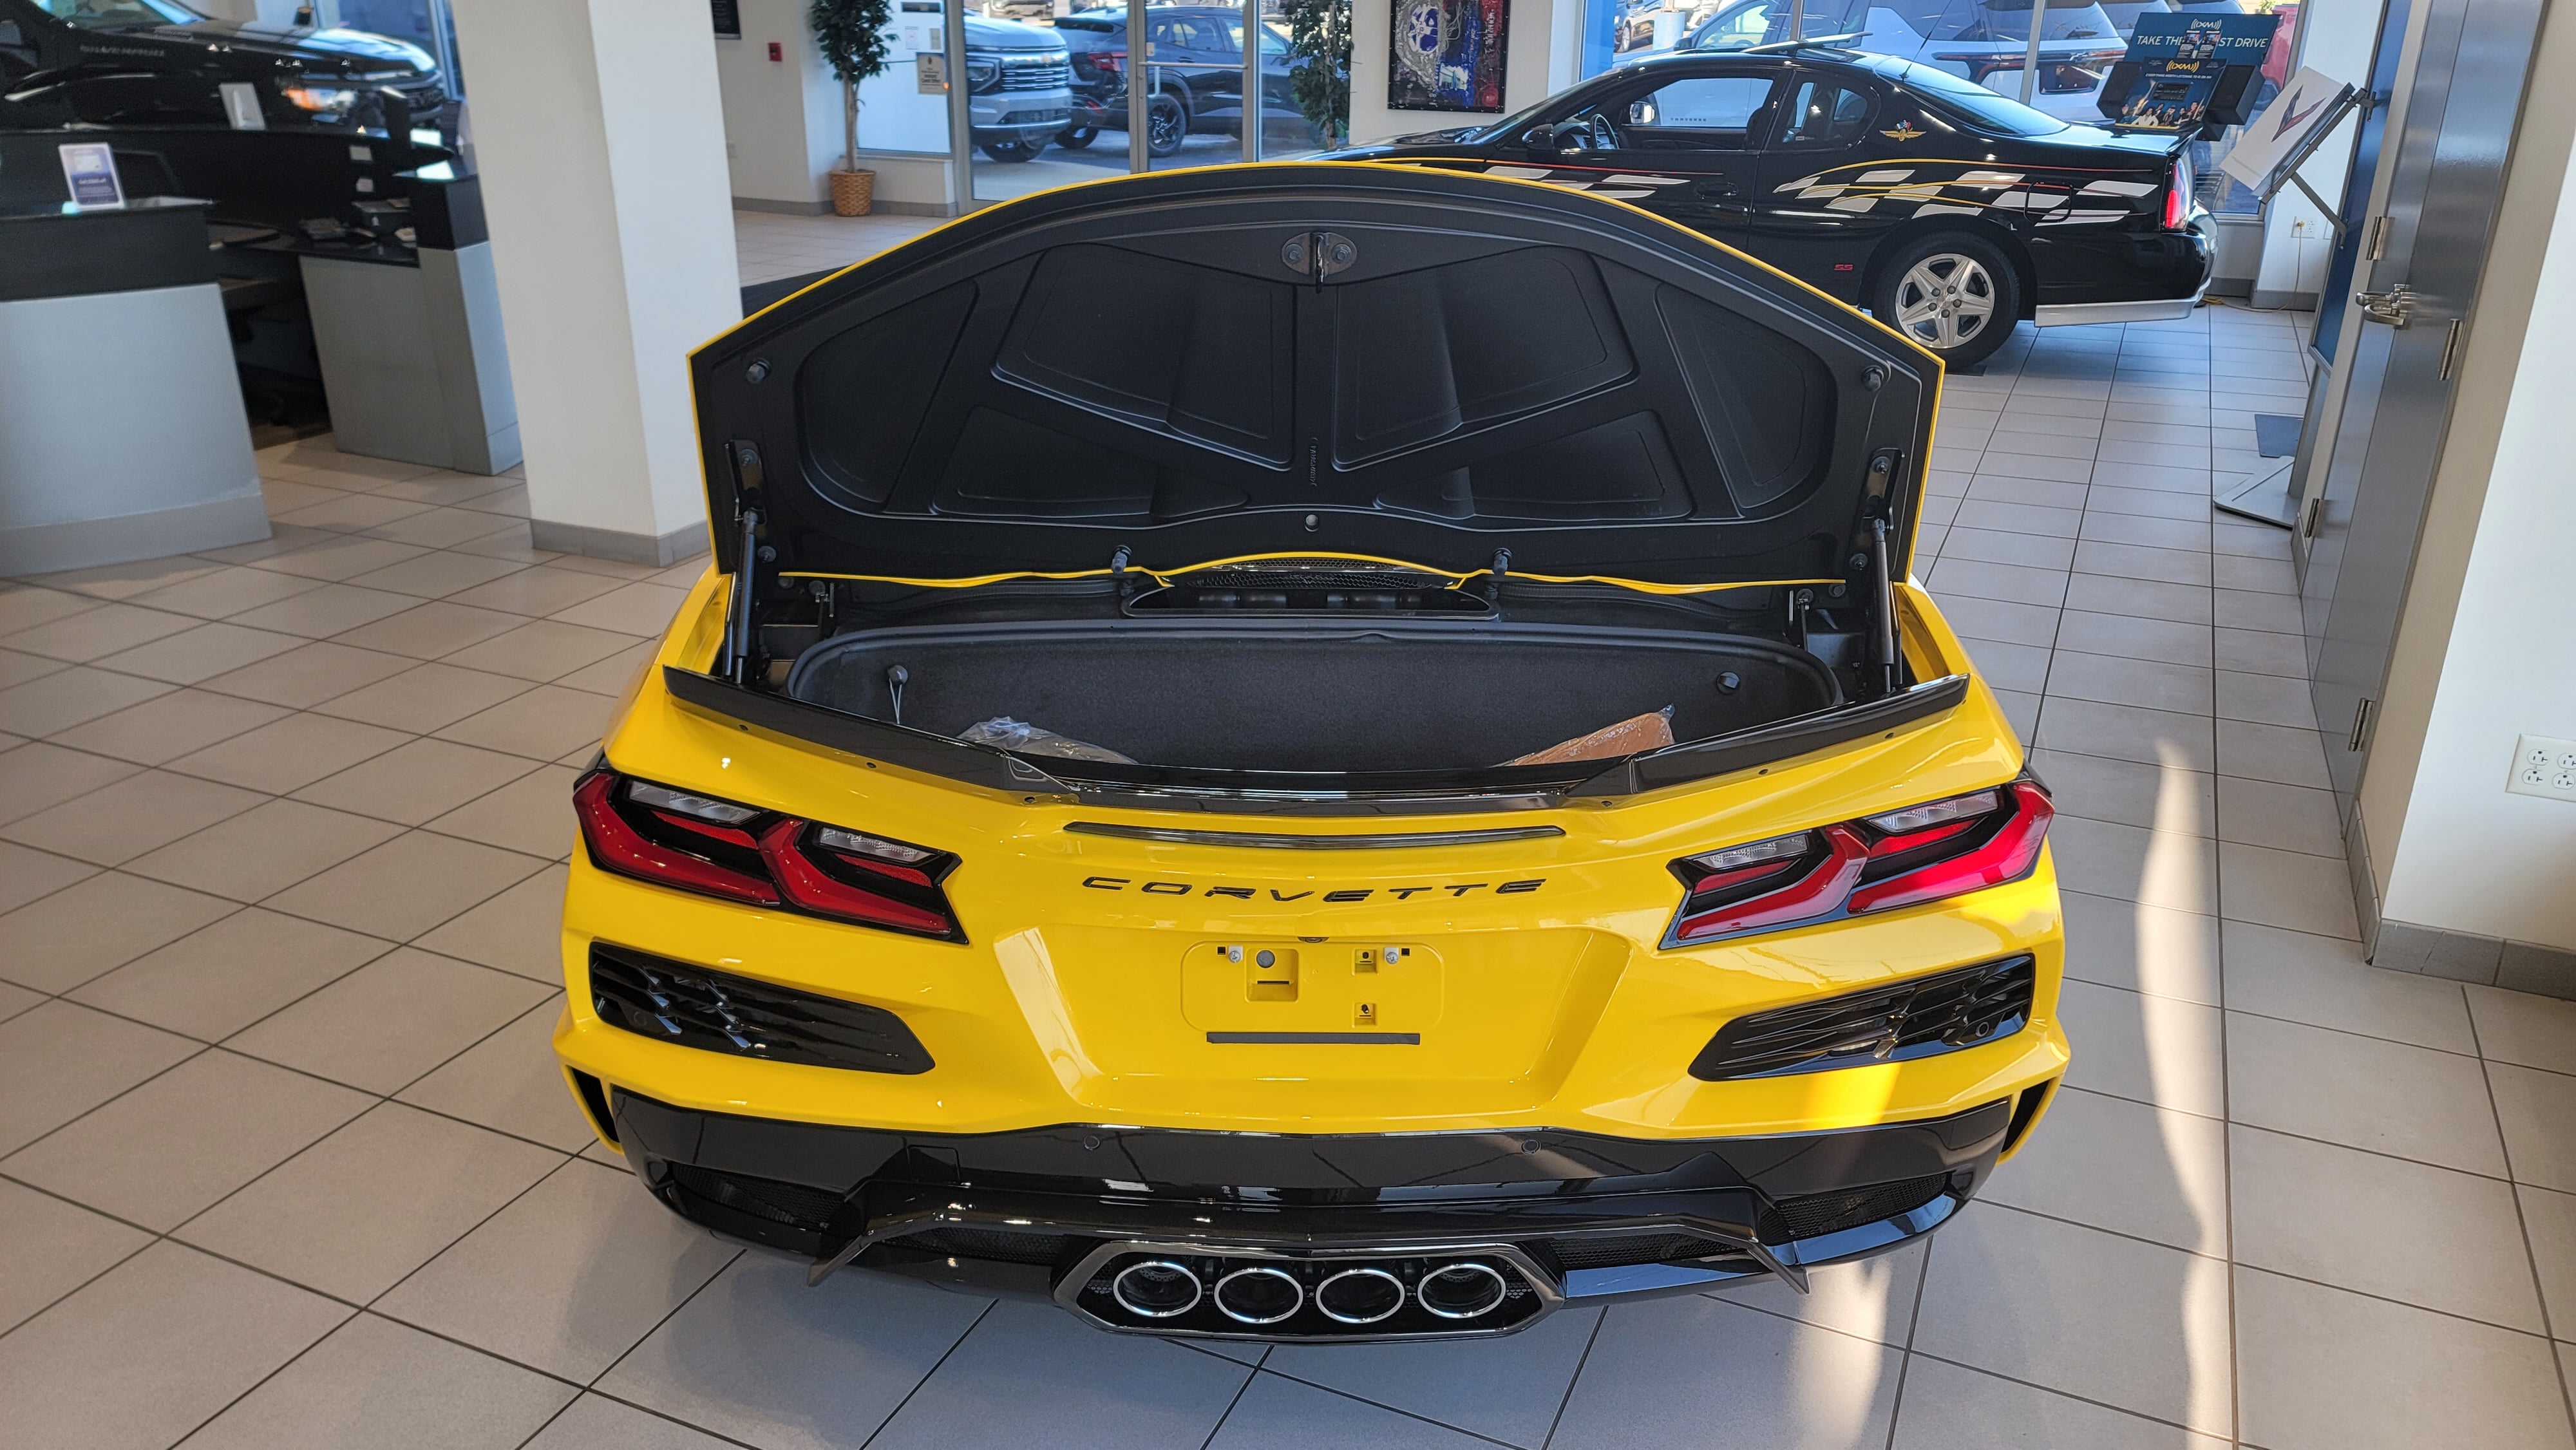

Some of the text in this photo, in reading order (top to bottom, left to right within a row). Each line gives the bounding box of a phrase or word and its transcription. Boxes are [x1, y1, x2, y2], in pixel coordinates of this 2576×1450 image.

[2137, 35, 2163, 45] TAKE
[2235, 38, 2268, 47] DRIVE
[1082, 876, 1547, 903] CORVETTE
